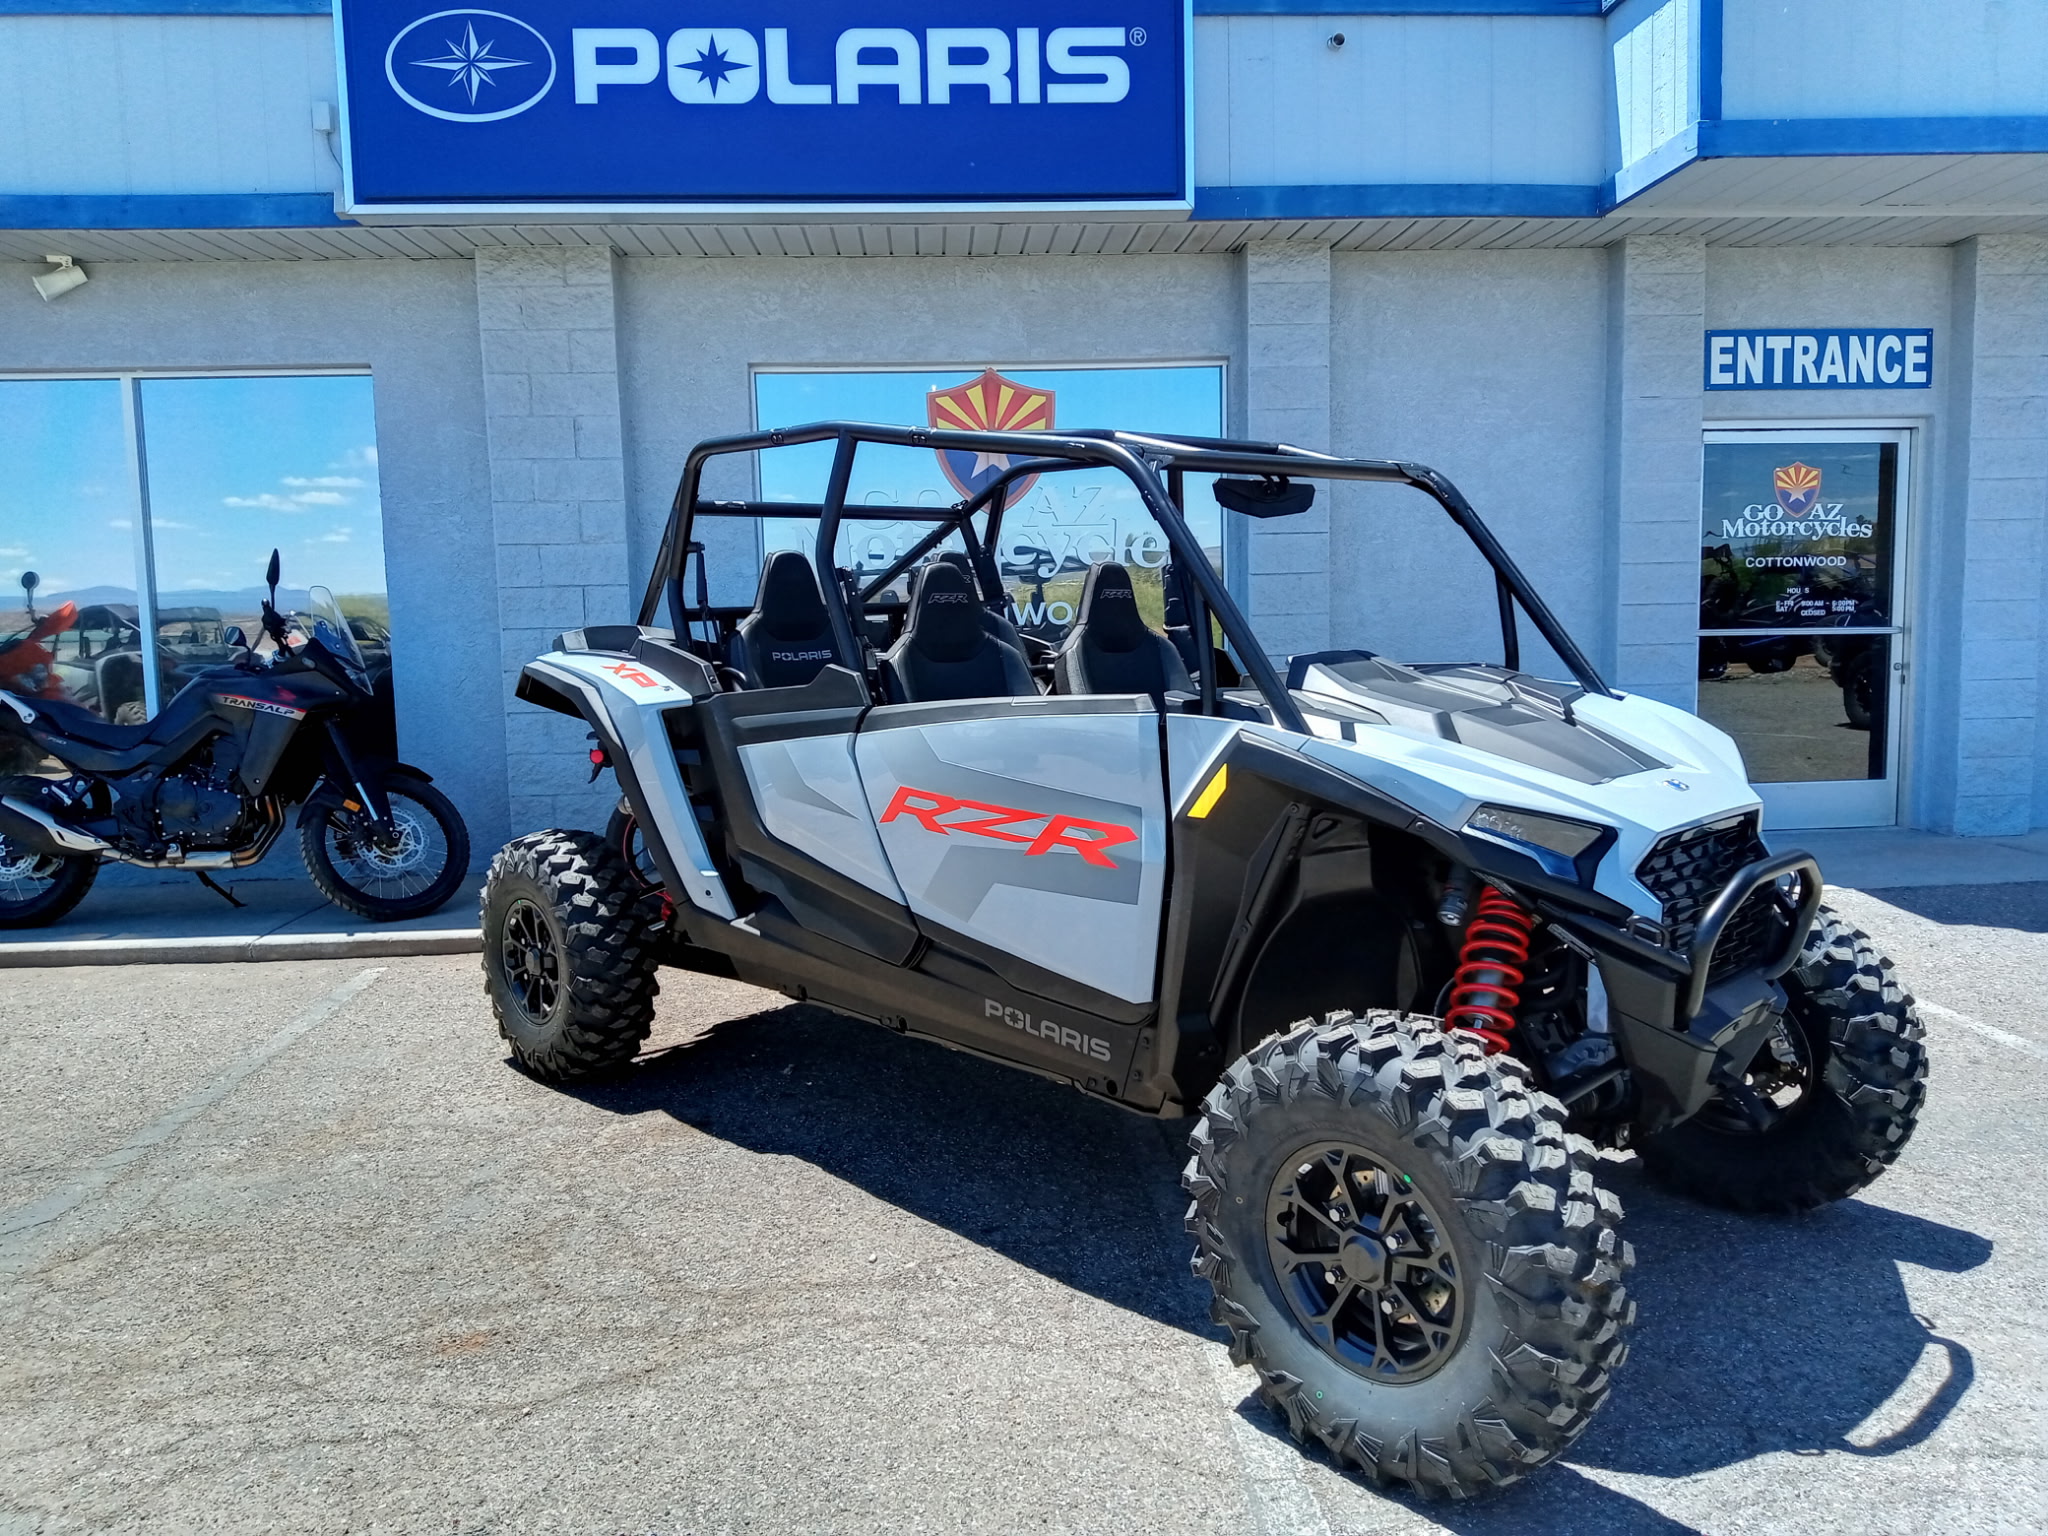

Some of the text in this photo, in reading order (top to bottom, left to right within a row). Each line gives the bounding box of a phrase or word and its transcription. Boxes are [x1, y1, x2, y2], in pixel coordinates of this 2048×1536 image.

[1710, 335, 1928, 384] ENTRANCE
[1743, 503, 1844, 521] GO AZ
[1721, 516, 1873, 541] Motorcycles
[1745, 556, 1847, 568] COTTONWOOD
[772, 650, 832, 661] POLARIS
[223, 696, 295, 715] TRANSALP
[879, 786, 1139, 869] RZR
[985, 998, 1111, 1062] POLARIS
